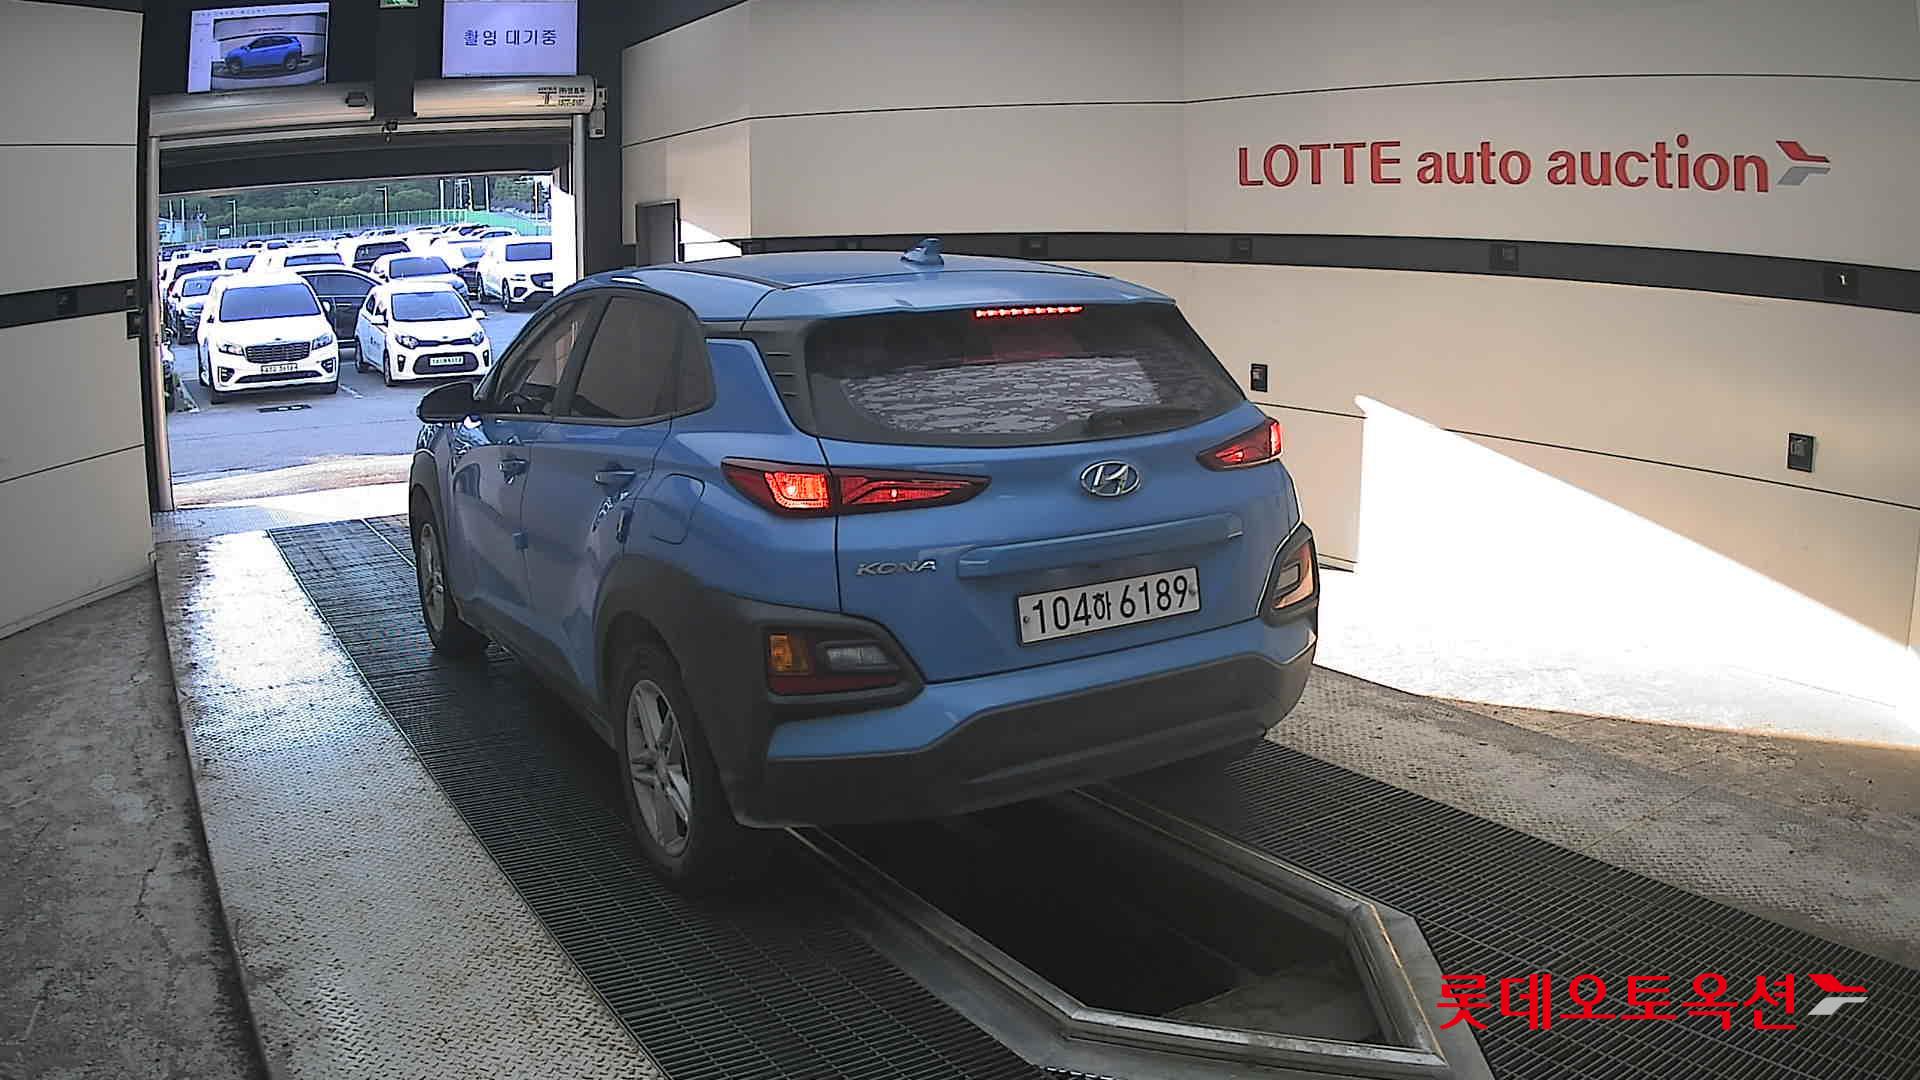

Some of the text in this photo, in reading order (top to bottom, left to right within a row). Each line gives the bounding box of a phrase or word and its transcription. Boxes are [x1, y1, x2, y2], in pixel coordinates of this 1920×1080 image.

[505, 29, 557, 46] 대기중
[1240, 134, 1768, 192] LOTTE auto auction
[856, 560, 936, 575] KONA
[1032, 575, 1188, 634] 104하 6189
